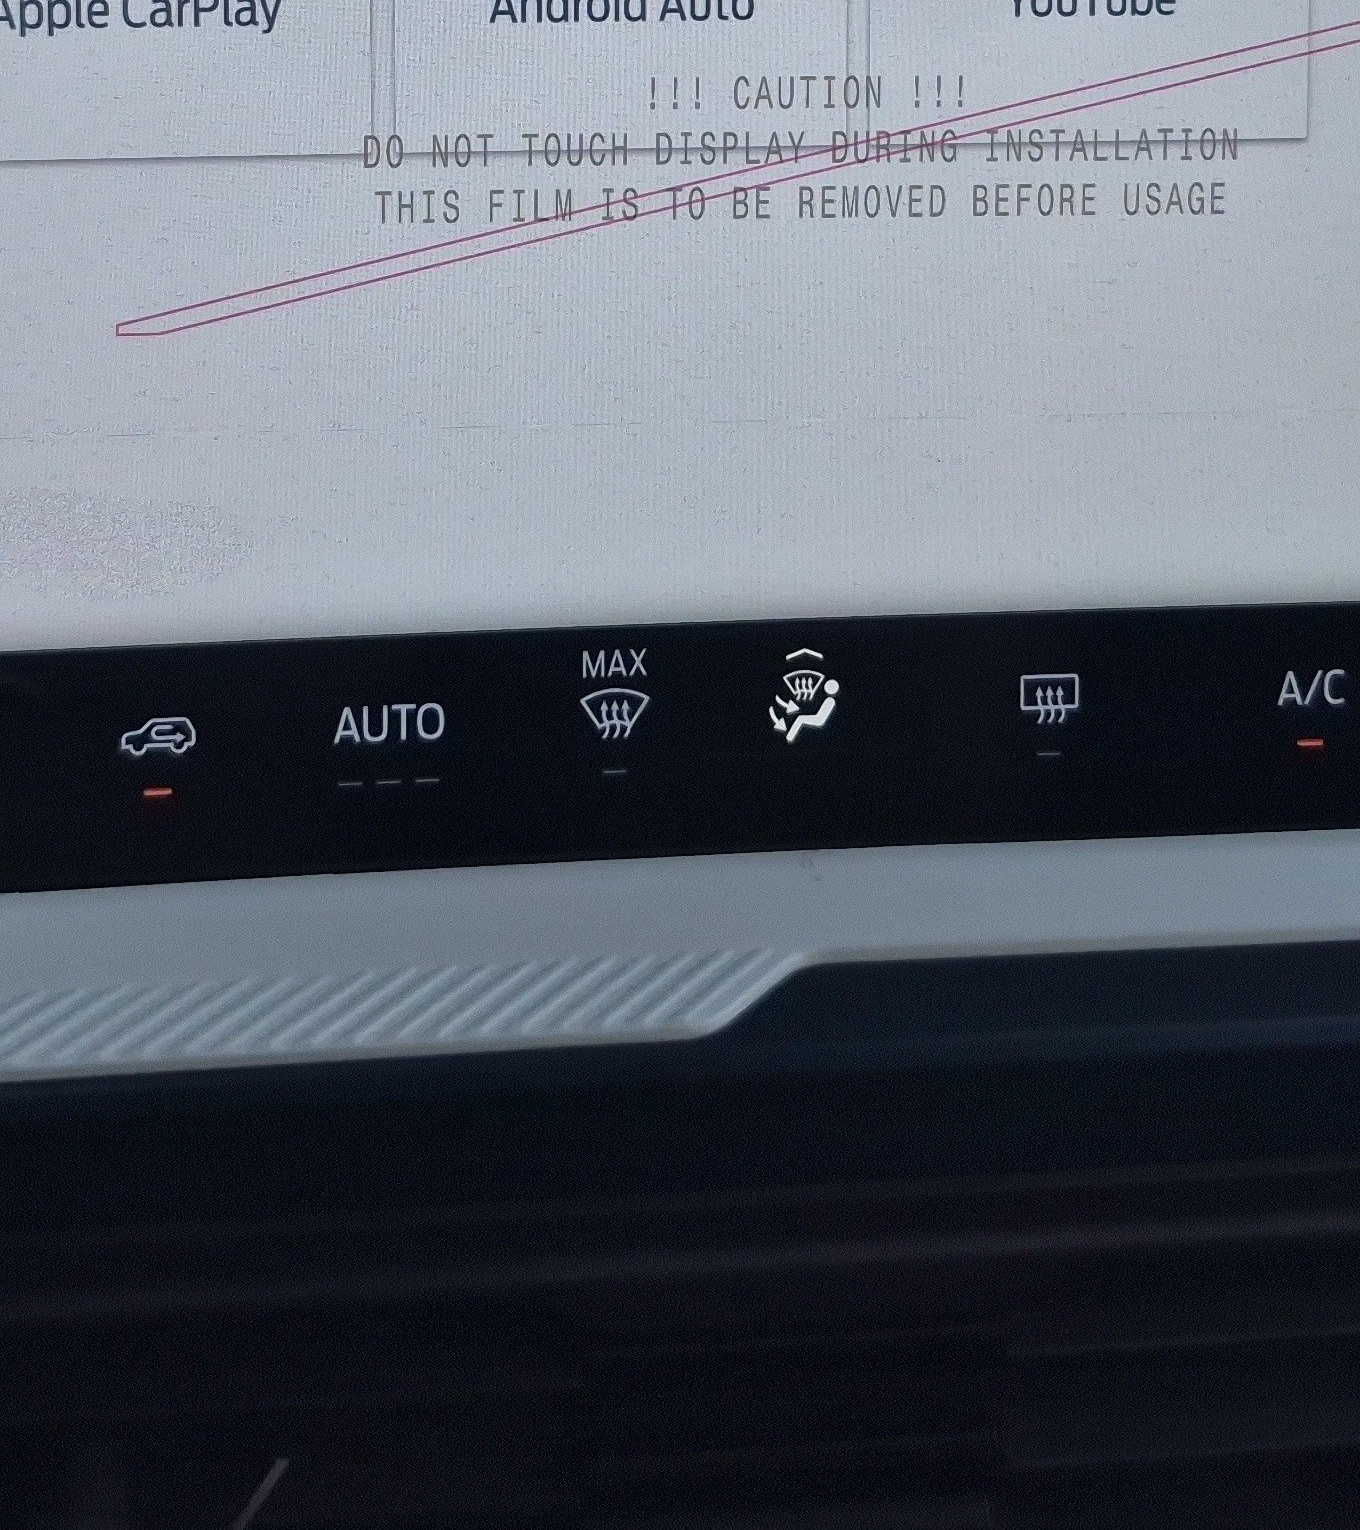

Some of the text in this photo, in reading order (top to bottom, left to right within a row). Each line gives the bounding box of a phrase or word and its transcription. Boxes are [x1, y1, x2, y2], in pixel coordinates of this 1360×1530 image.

[733, 75, 883, 110] CAUTION
[362, 127, 1241, 170] DO NOT TOUCH DISPLAY DURING INSTALLATION
[375, 182, 1227, 224] THIS FILM IS TO BE REMOVED BEFORE USAGE
[581, 648, 648, 678] MAX
[1277, 669, 1346, 707] A/C
[333, 702, 446, 745] AUTO
